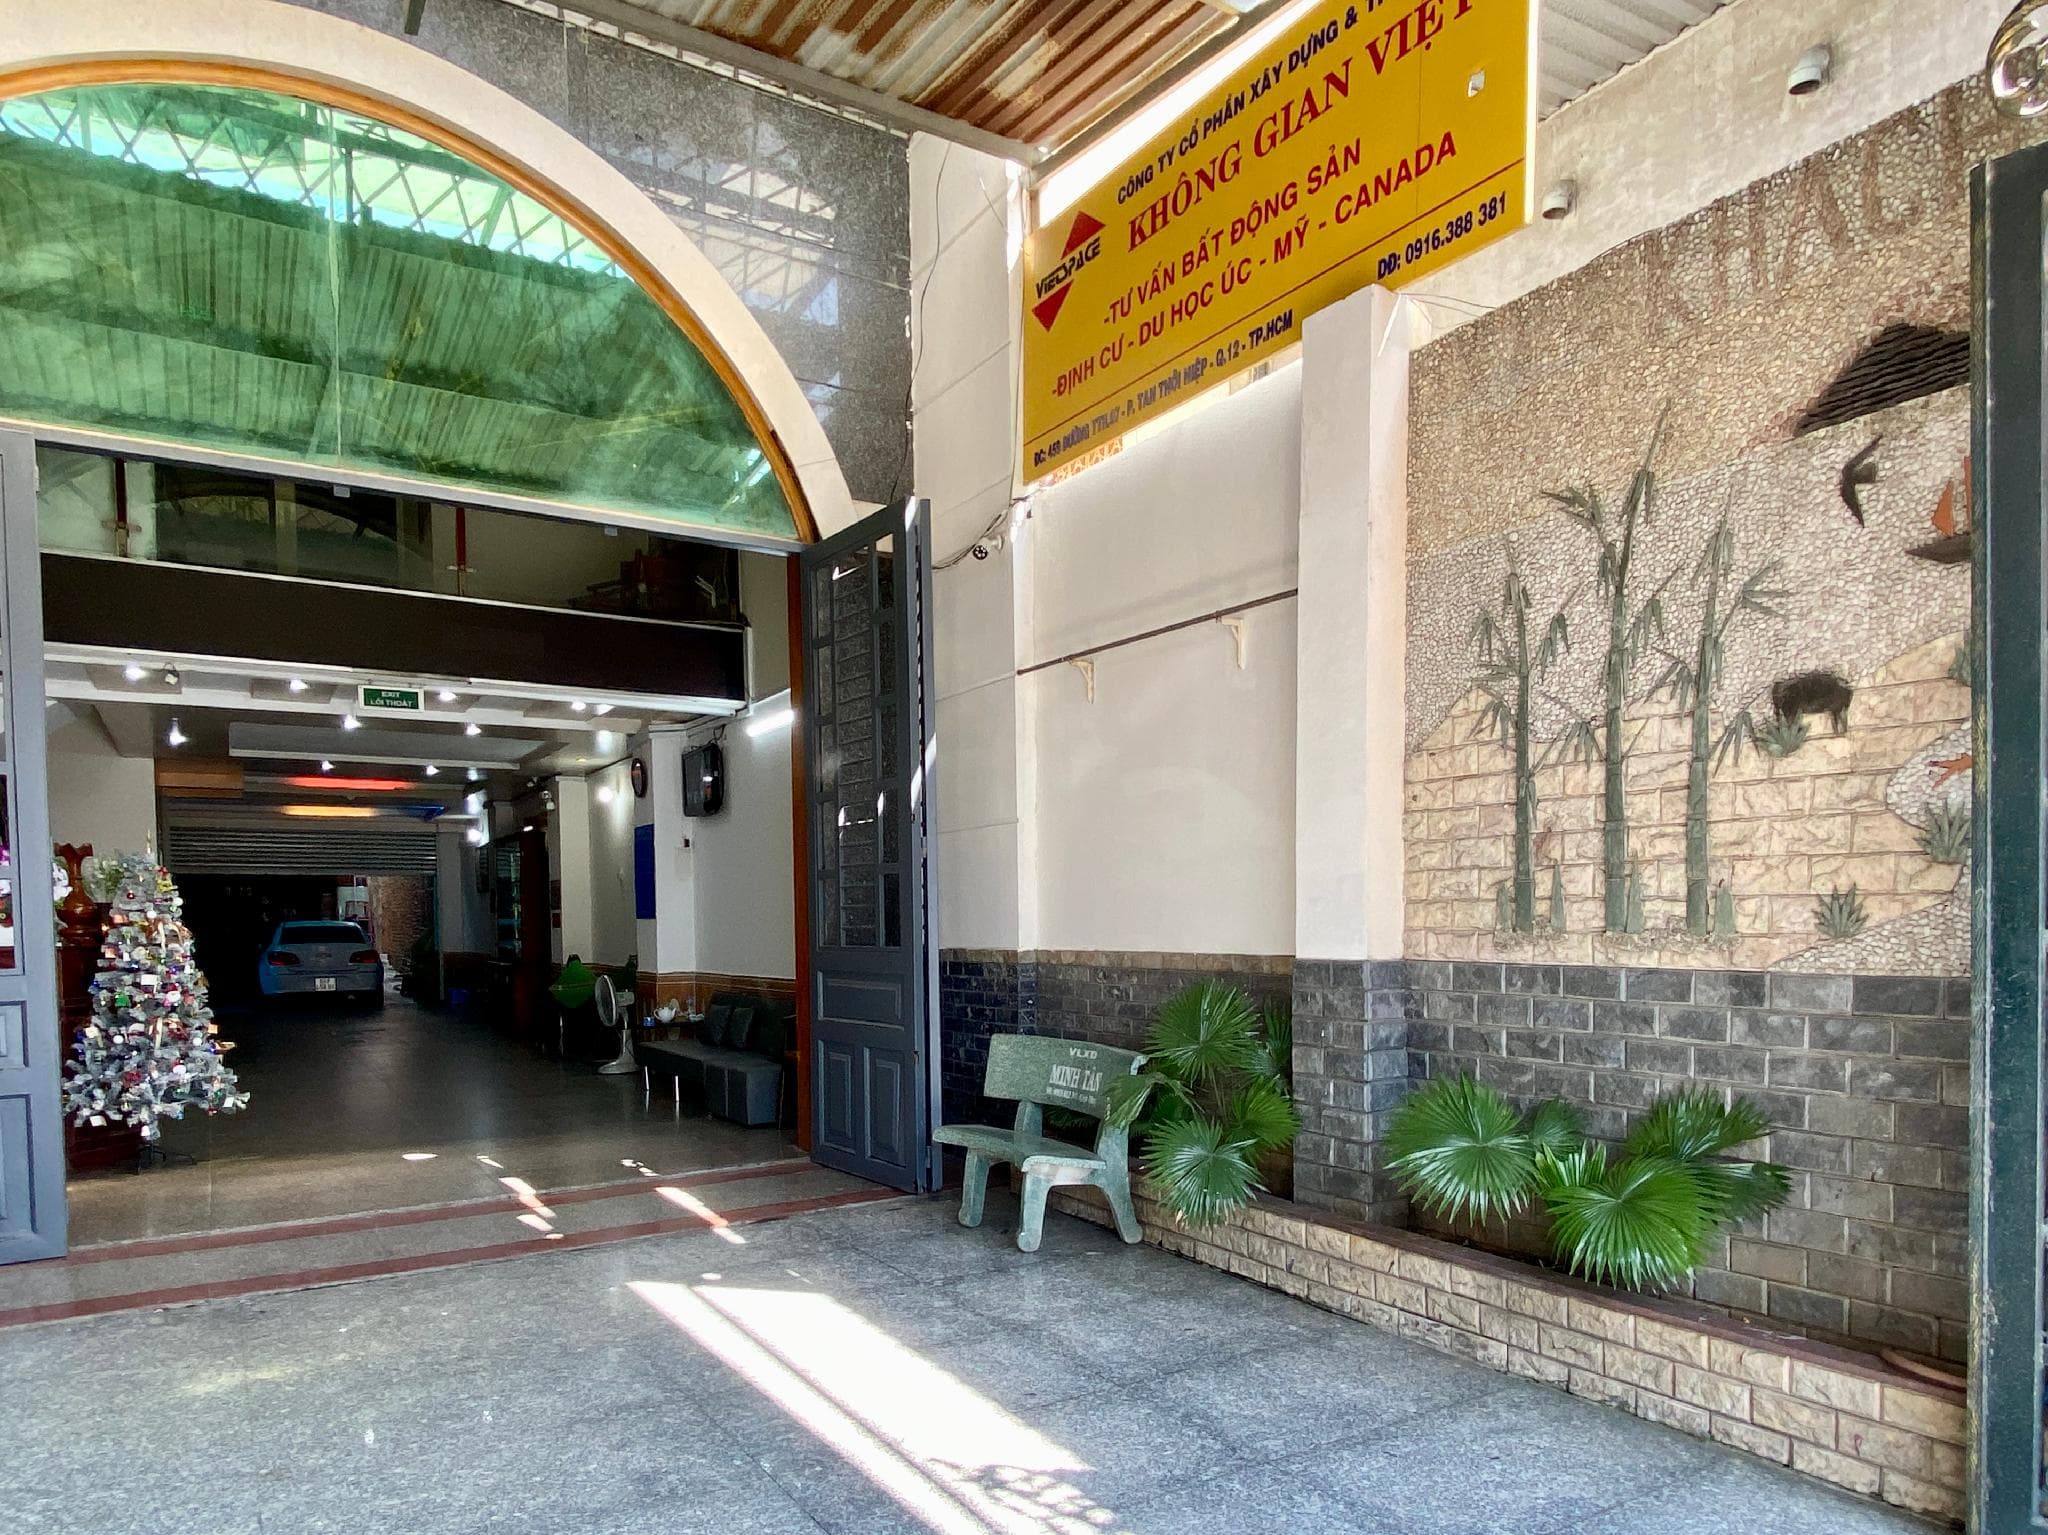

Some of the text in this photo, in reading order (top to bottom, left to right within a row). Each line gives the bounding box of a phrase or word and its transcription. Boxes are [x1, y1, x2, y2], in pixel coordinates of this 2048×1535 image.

[1118, 165, 1153, 204] CÔNG
[1158, 144, 1175, 173] TY
[1179, 118, 1199, 156] CỔ
[1250, 61, 1283, 104] XÂY
[1288, 19, 1339, 73] DỰNG
[1344, 6, 1358, 29] &
[1128, 140, 1242, 252] KHÔNG
[1254, 57, 1353, 157] GIAN
[1100, 333, 1124, 369] CƯ
[1140, 311, 1165, 346] DU
[1170, 281, 1214, 327] HỌC
[1221, 257, 1252, 294] ÚC
[1274, 213, 1309, 264] MỸ
[1335, 130, 1456, 225] CANADA
[1138, 261, 1175, 305] VẤN
[1182, 227, 1224, 278] BẤT
[1230, 182, 1298, 246] ĐỘNG
[1307, 137, 1360, 195] SẢN
[1405, 211, 1472, 264] 0916.388
[1478, 191, 1506, 226] 381
[1249, 309, 1293, 349] TP.HCM
[1049, 1064, 1081, 1088] MINH
